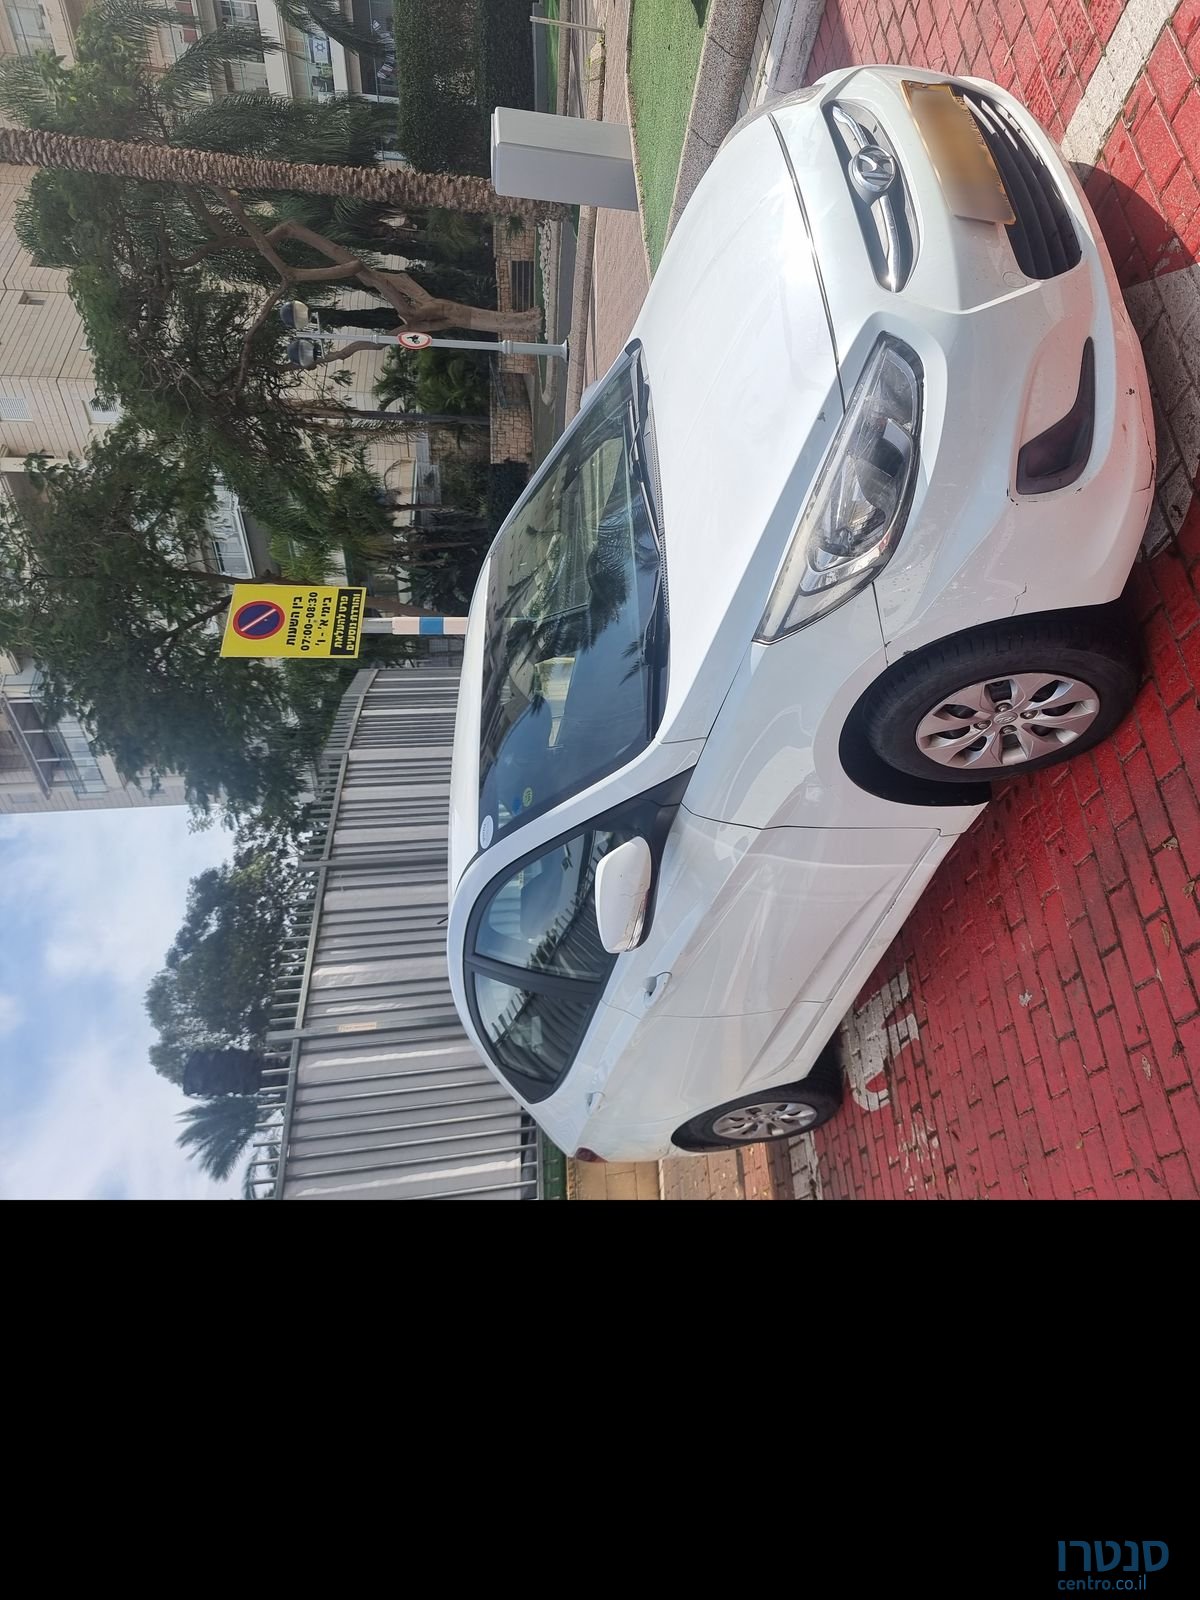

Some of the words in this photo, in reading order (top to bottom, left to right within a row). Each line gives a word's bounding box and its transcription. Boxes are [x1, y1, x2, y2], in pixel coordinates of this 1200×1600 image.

[292, 596, 303, 609] בין
[320, 597, 332, 618] בימי
[339, 595, 349, 612] פרט
[350, 593, 360, 621] והורדת
[286, 611, 300, 646] השעות
[301, 592, 318, 650] 07:00-08:30
[334, 613, 346, 648] להעלאת
[346, 622, 358, 651] נוסעים
